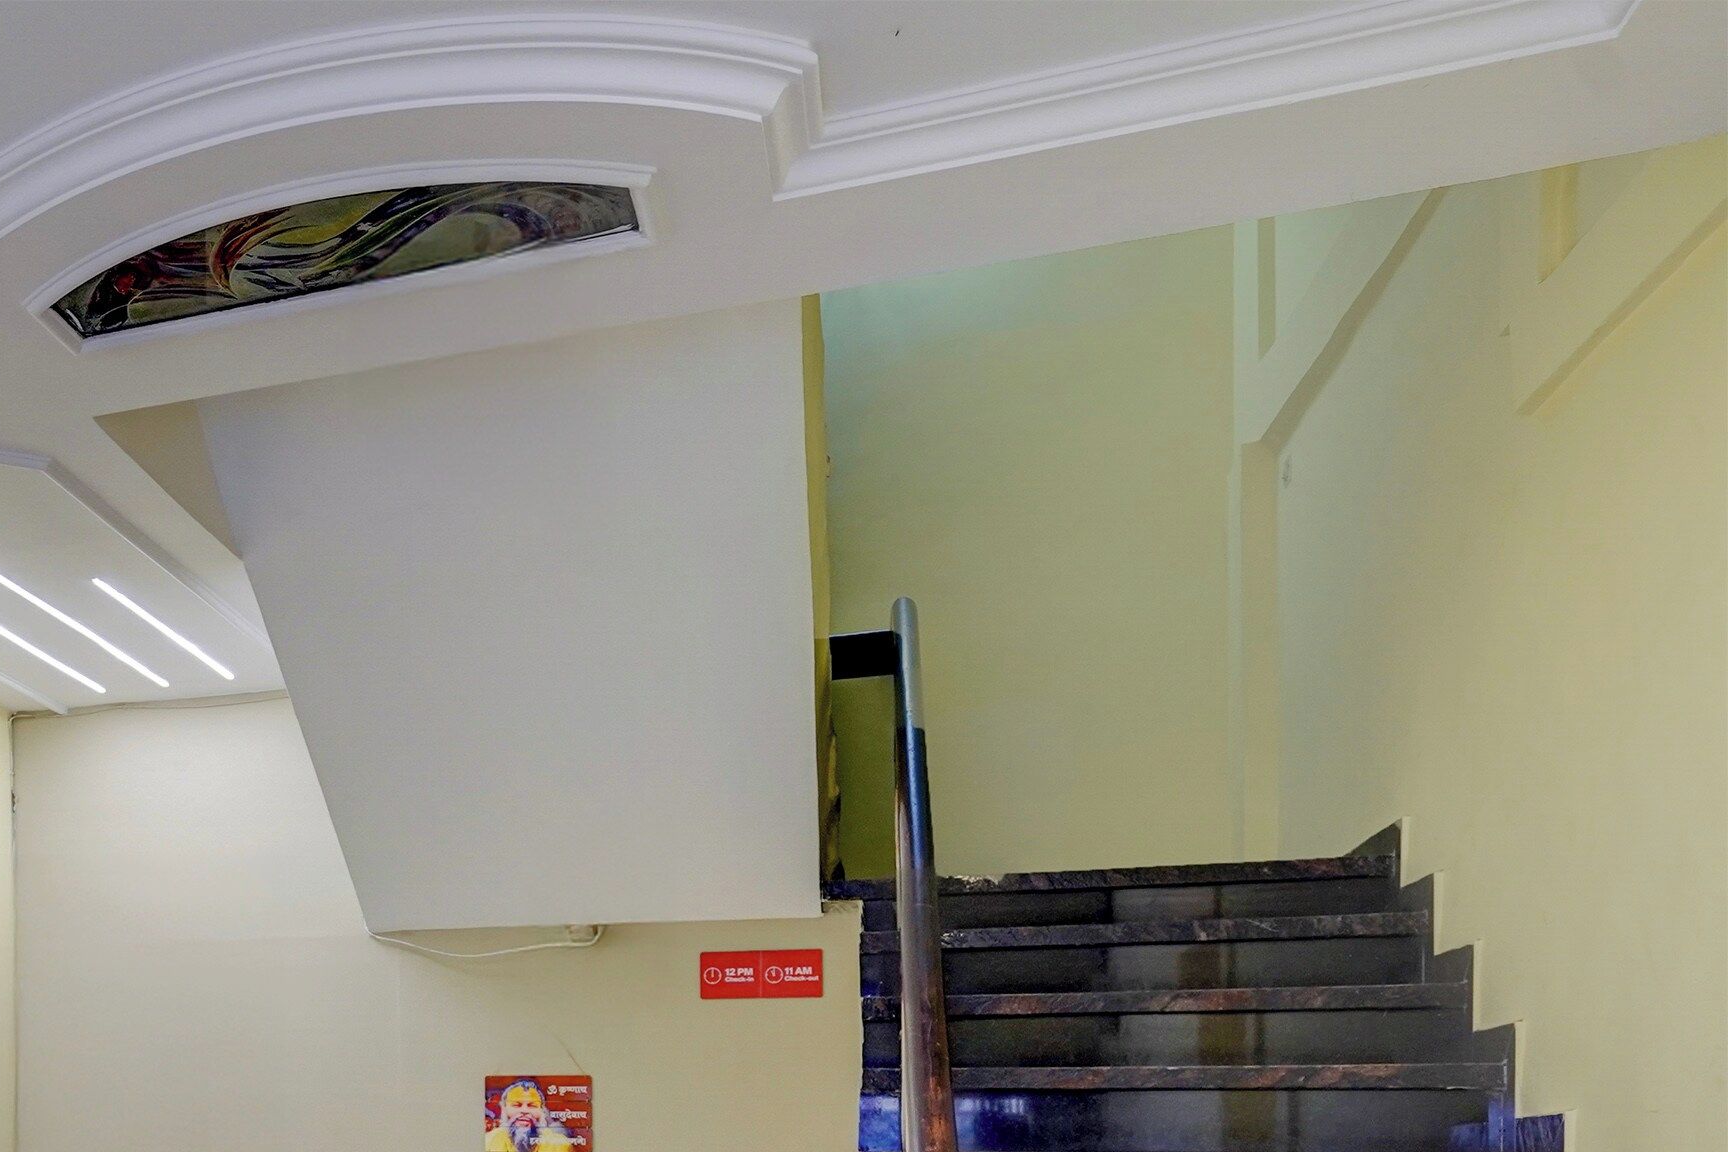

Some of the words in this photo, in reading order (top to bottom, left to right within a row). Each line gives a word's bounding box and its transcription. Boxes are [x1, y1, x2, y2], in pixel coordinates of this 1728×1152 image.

[725, 967, 736, 976] 12
[737, 967, 753, 976] PM
[784, 966, 794, 975] 11
[795, 966, 812, 975] AM
